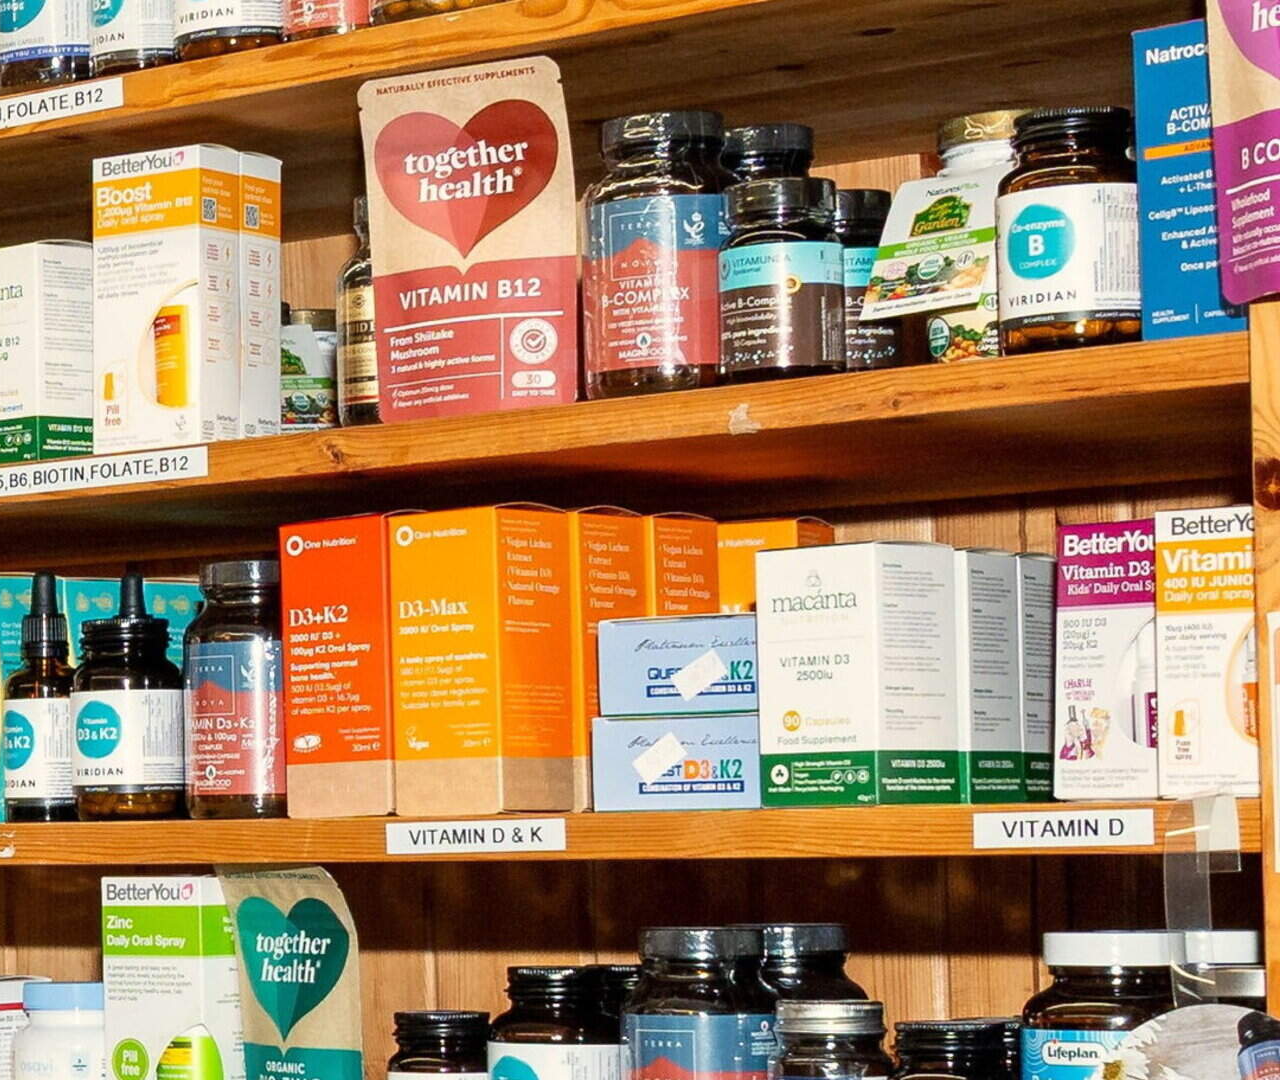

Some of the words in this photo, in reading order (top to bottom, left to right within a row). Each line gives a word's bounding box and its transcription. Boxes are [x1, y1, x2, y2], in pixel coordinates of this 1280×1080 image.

[376, 79, 424, 96] NATURALLY
[427, 73, 471, 88] EFFECTIVE
[473, 66, 535, 83] SUPPLEMENTS
[100, 154, 173, 178] BetterYou
[404, 139, 528, 178] together
[95, 182, 152, 206] Boost
[1028, 234, 1045, 257] B
[399, 282, 488, 311] VITAMIN
[497, 277, 541, 300] B12
[1008, 288, 1078, 307] VIRIDIAN
[1063, 562, 1123, 581] Vitamin
[398, 599, 469, 620] D3-Max
[771, 589, 857, 614] macánta
[289, 605, 349, 627] D3+K2
[780, 655, 829, 668] VITAMIN
[833, 654, 850, 666] D3
[776, 735, 802, 747] Food
[804, 732, 857, 746] Supplement
[76, 767, 124, 778] VIRIDIAN
[409, 829, 486, 847] VITAMIN
[493, 828, 506, 845] D
[512, 828, 525, 844] &
[531, 827, 543, 843] K
[1001, 819, 1100, 839] VITAMIN
[1109, 819, 1124, 837] D
[106, 882, 181, 904] BetterYou
[106, 916, 134, 930] Zinc
[106, 936, 132, 950] Daily
[134, 935, 156, 947] Oral
[158, 934, 186, 950] Spray
[254, 930, 330, 958] together
[1046, 1044, 1099, 1061] Lifeplan
[264, 1061, 306, 1075] ORGANIC
